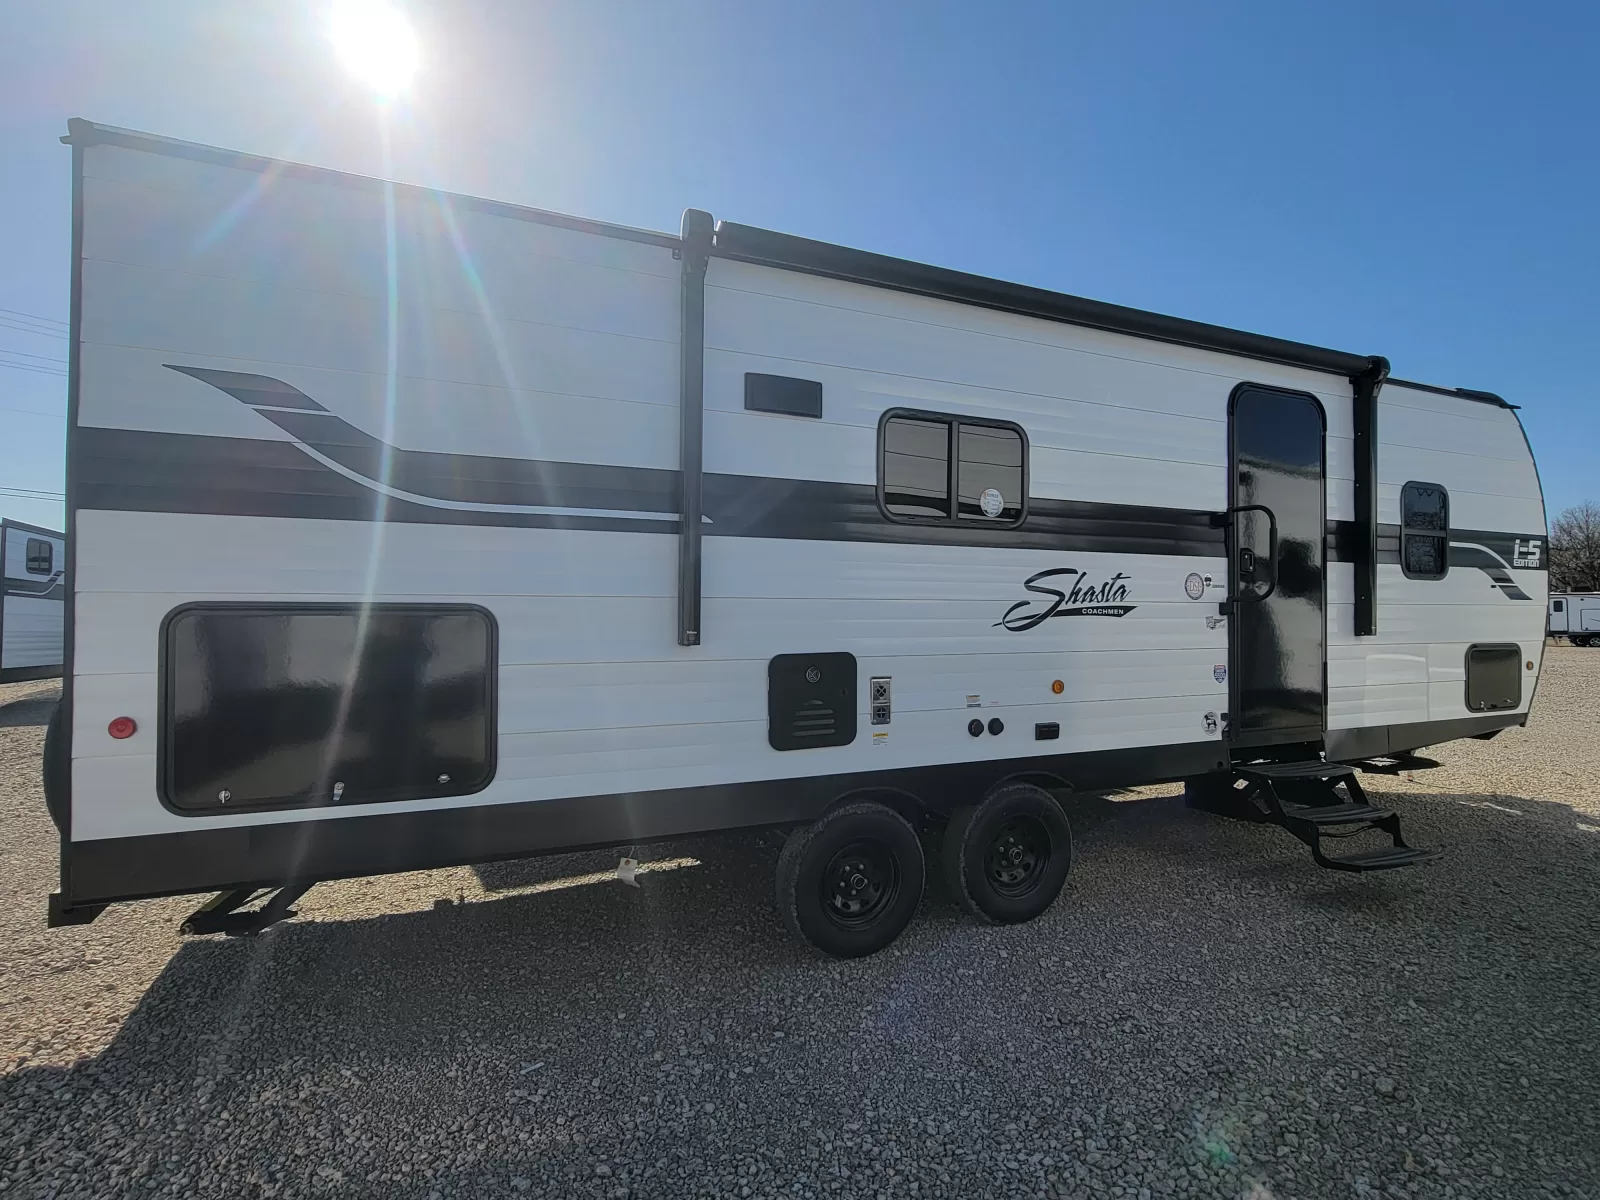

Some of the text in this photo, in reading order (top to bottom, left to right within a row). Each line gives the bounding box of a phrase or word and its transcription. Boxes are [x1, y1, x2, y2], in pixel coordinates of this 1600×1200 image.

[1513, 539, 1541, 559] i-5
[1513, 559, 1540, 567] EDITION
[1002, 567, 1132, 632] Shasta
